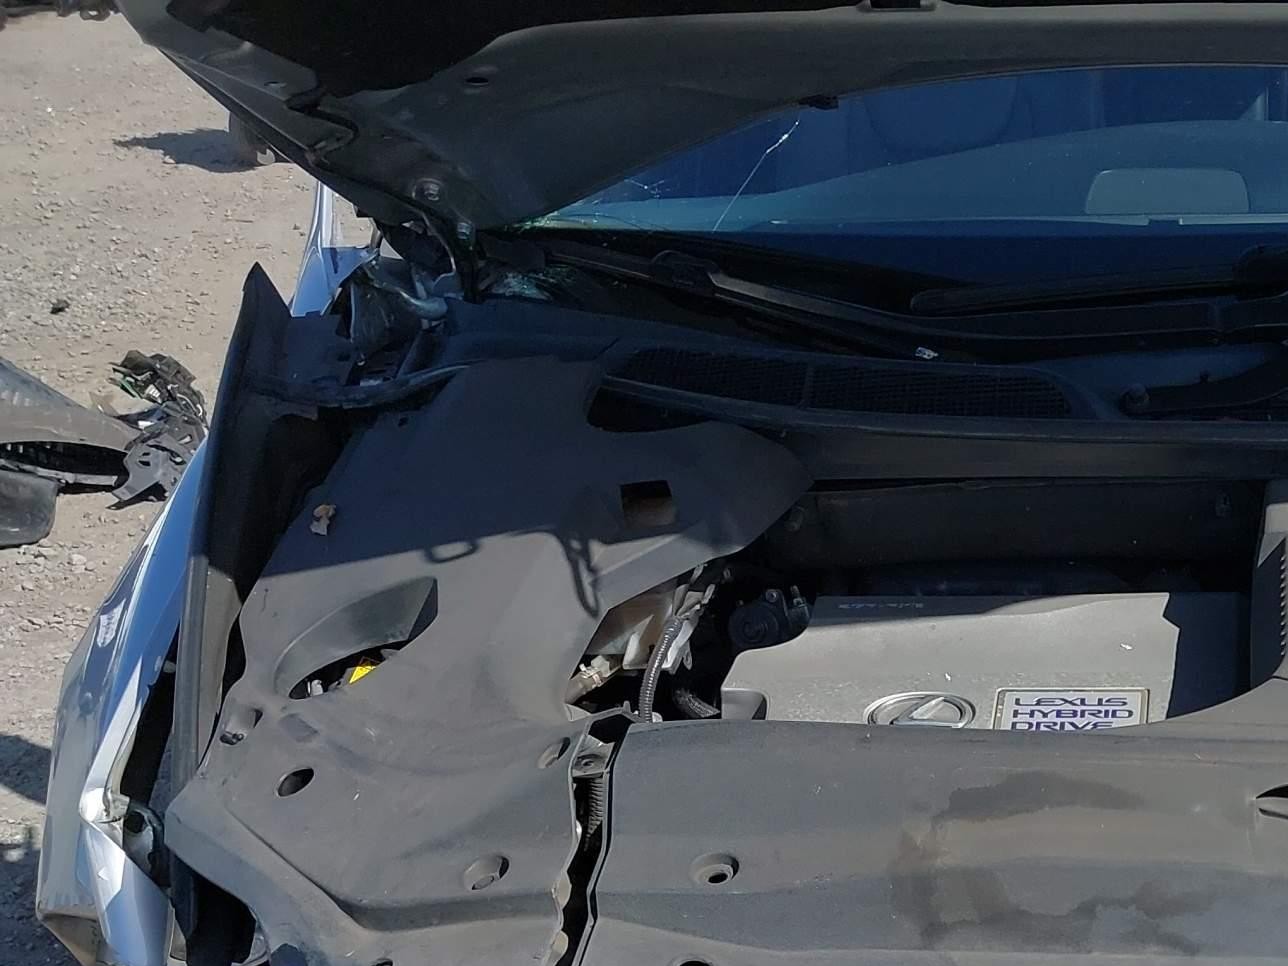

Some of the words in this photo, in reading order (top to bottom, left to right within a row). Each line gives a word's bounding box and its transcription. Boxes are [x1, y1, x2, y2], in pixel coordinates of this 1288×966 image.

[1014, 697, 1128, 707] LEXUS
[1012, 709, 1134, 719] HYBRID
[1010, 721, 1114, 731] DRIVE
